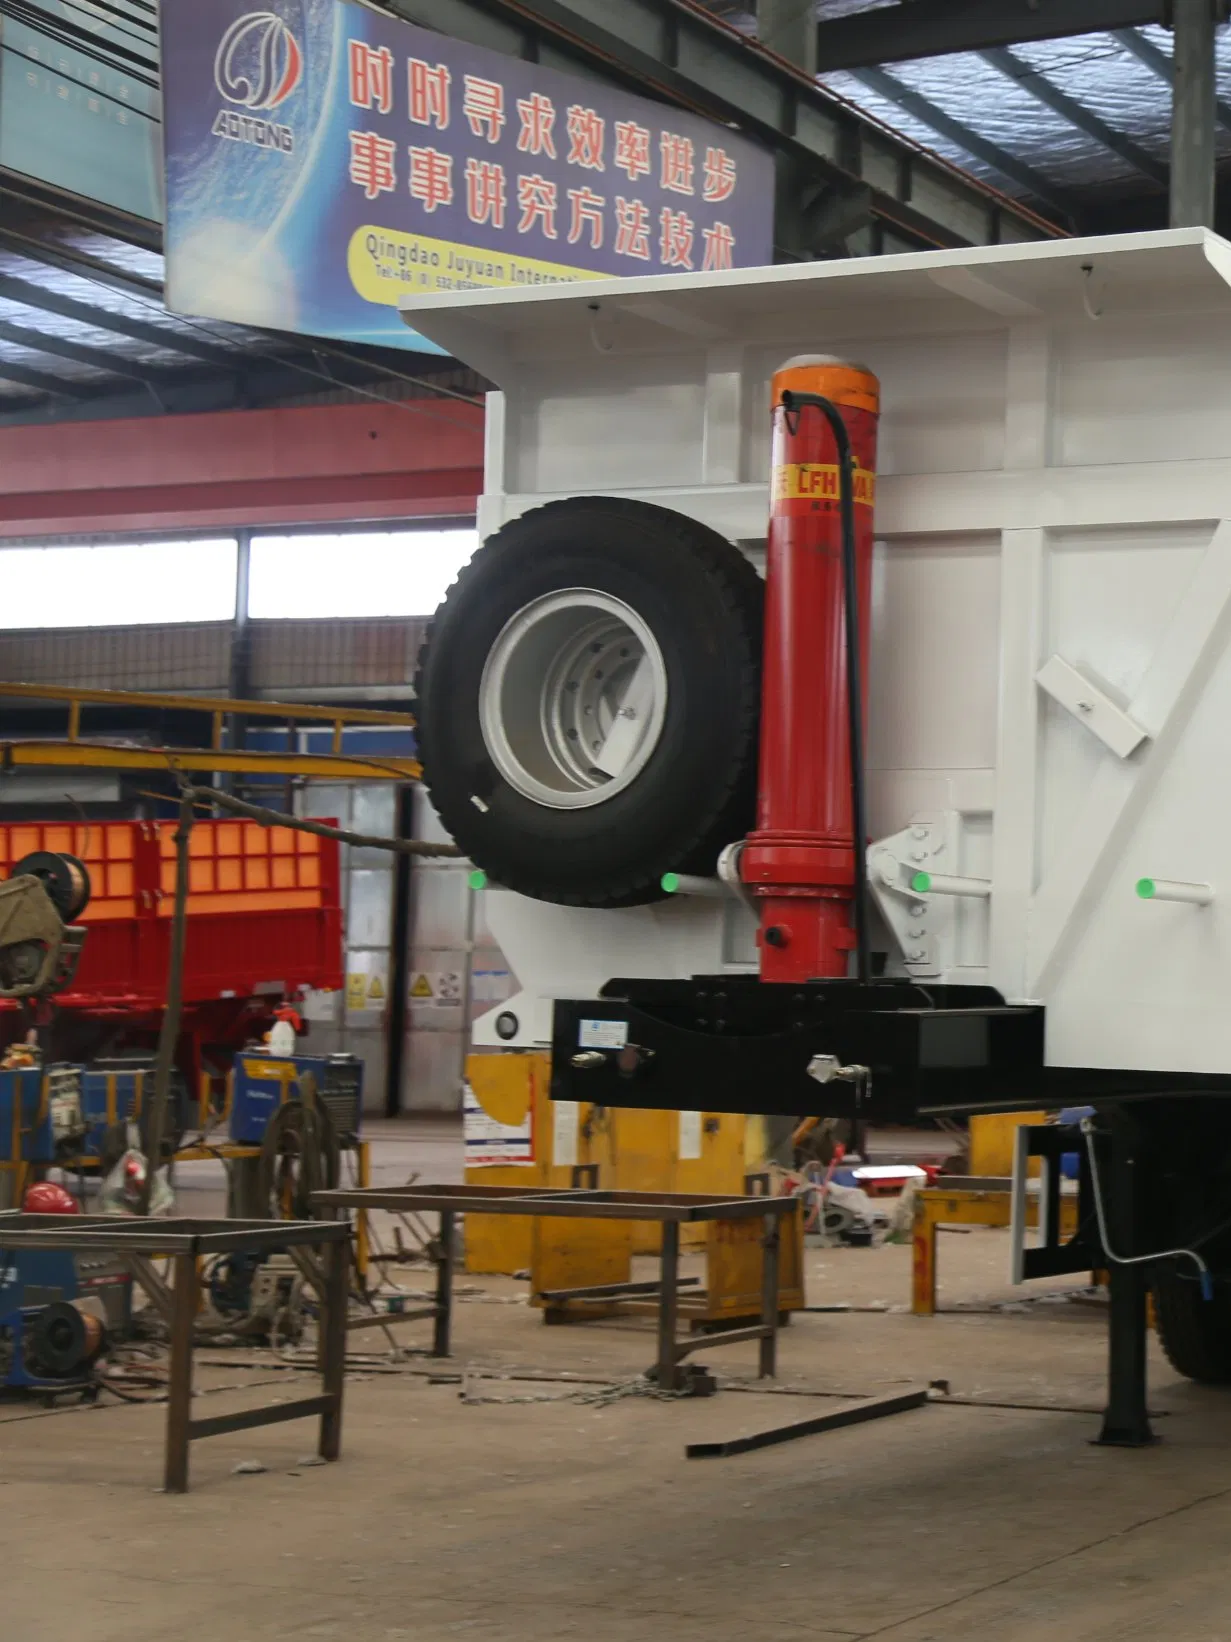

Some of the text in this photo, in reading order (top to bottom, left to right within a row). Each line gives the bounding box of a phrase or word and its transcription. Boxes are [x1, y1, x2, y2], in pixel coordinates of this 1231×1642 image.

[211, 109, 294, 155] AOTONG
[347, 38, 737, 202] 时时寻求效率进步
[348, 131, 737, 270] 事事讲究方法技术
[365, 233, 441, 269] Qingdao
[445, 251, 504, 280] Juyuan
